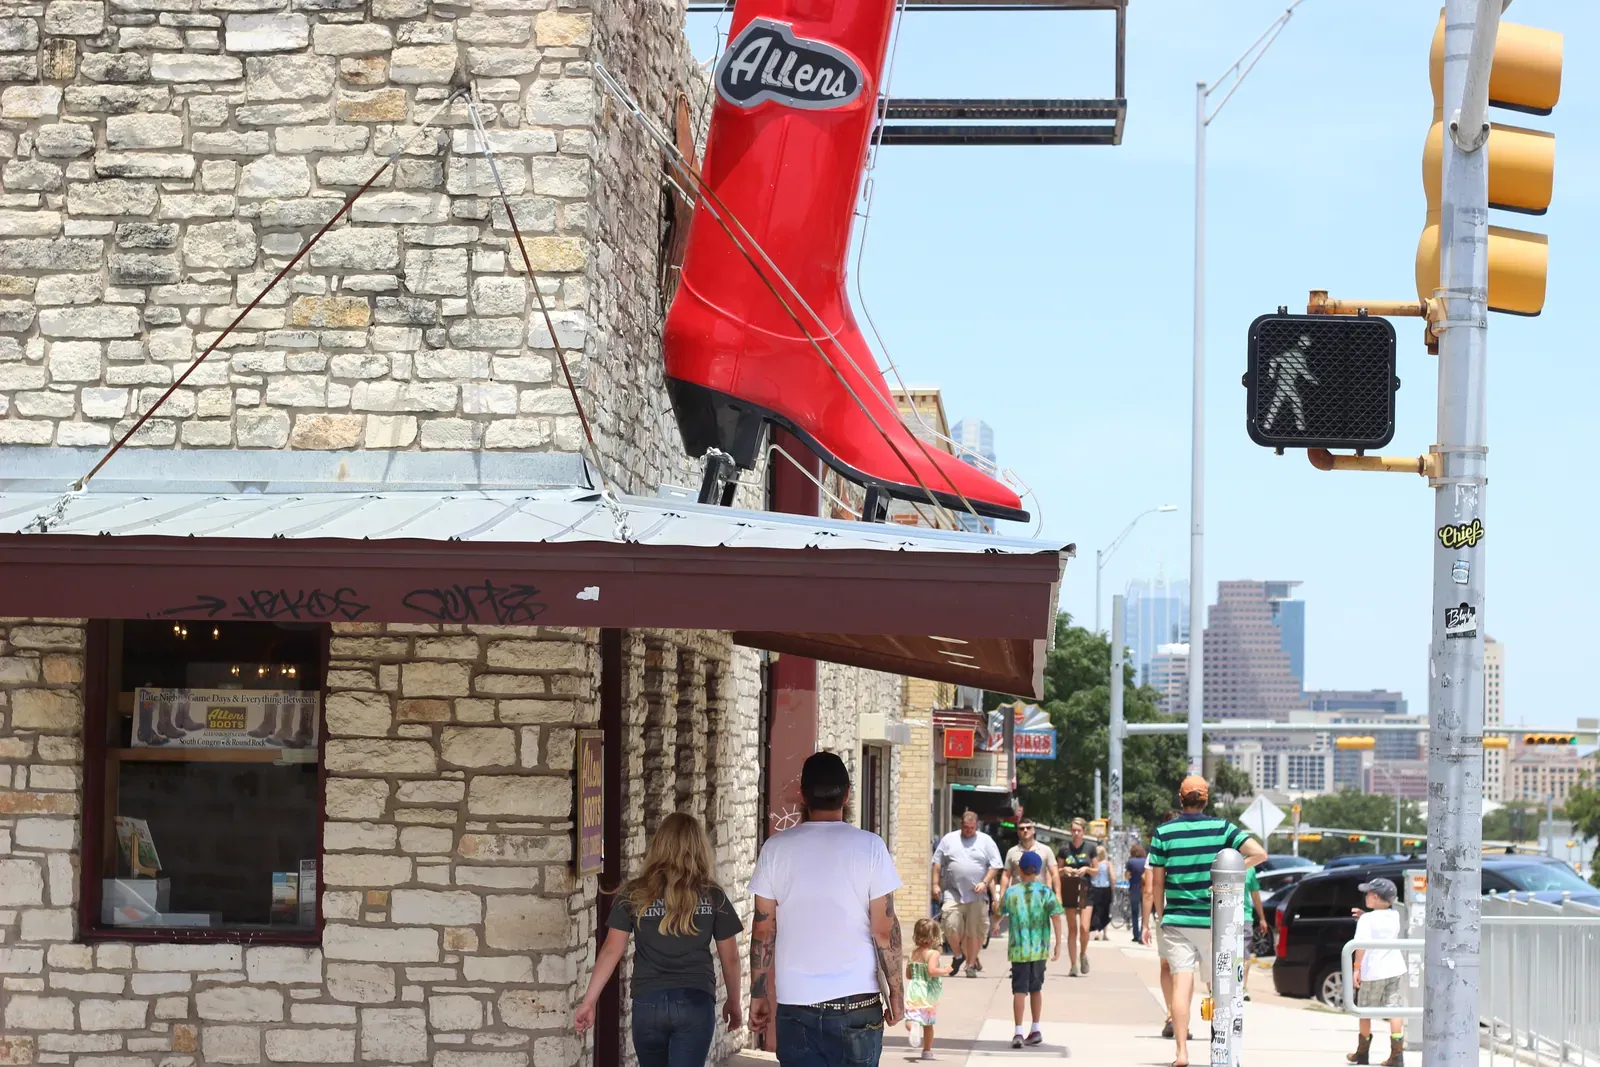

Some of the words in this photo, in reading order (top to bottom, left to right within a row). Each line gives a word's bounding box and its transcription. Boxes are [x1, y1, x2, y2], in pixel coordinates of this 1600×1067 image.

[730, 37, 847, 97] Allens
[1439, 520, 1484, 548] Chief
[188, 693, 210, 702] Game
[211, 694, 231, 704] Days
[232, 694, 240, 703] &
[241, 694, 282, 706] Everything
[208, 709, 244, 721] Allens
[210, 720, 244, 729] BOOTS
[251, 739, 266, 747] Rock
